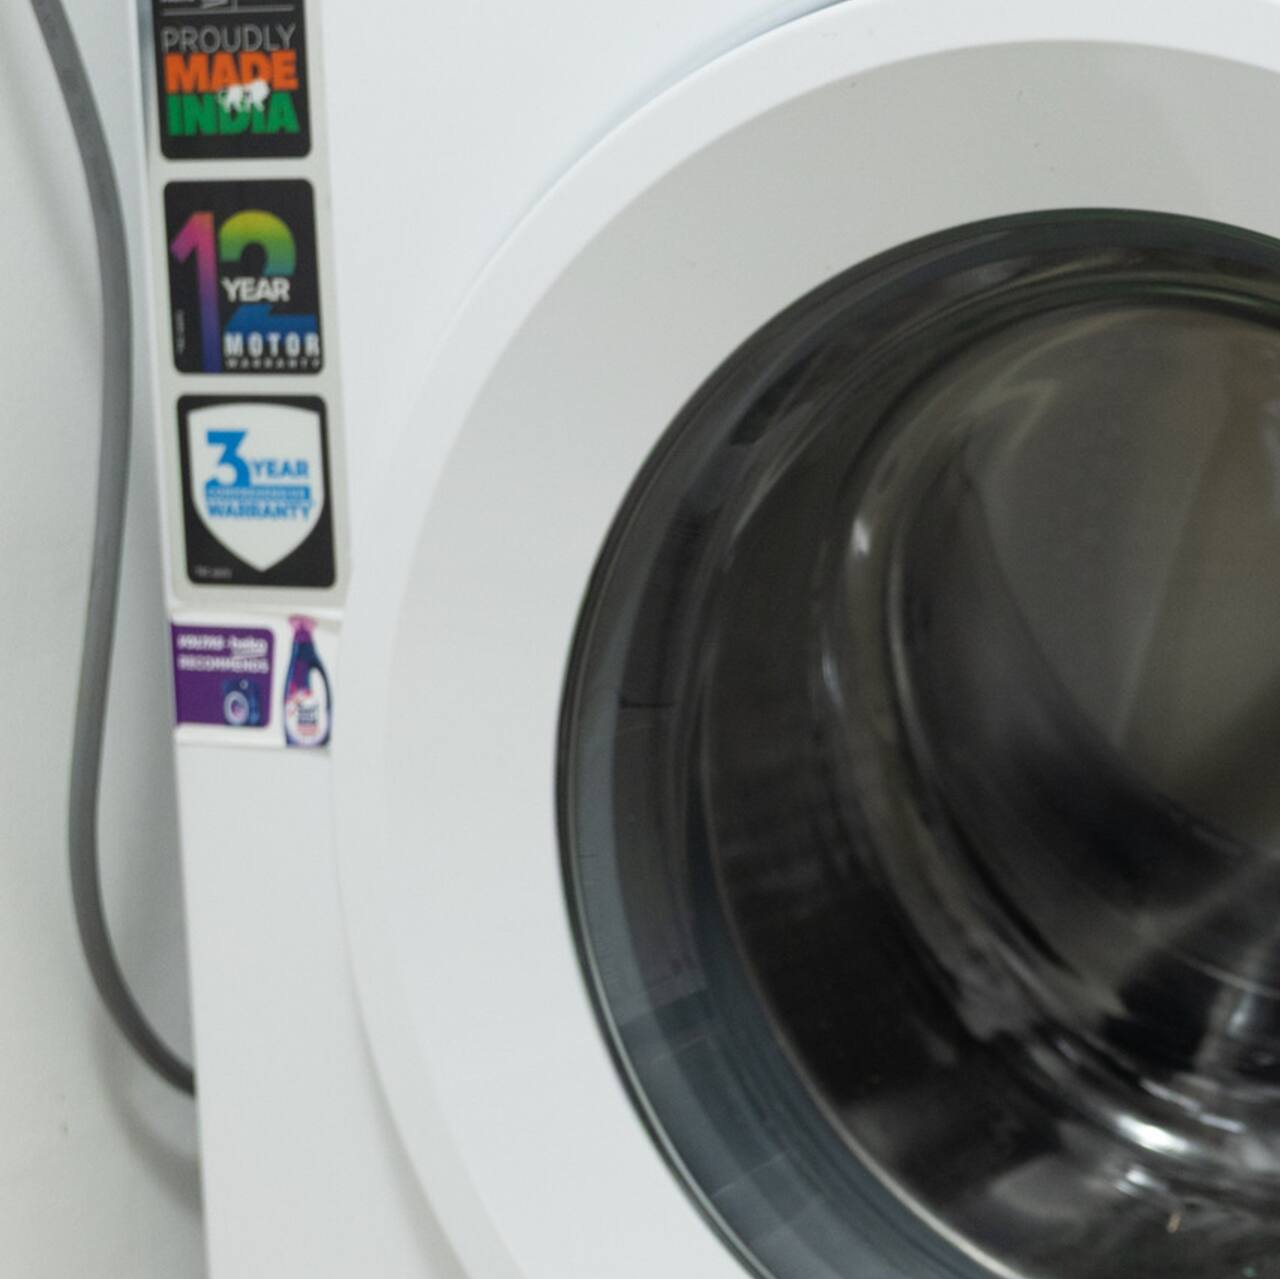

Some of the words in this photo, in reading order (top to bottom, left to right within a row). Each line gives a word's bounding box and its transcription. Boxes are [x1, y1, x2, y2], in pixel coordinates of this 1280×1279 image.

[161, 24, 296, 54] PROUDLY
[164, 49, 298, 94] MADE
[166, 90, 299, 136] INDIA
[221, 277, 291, 302] YEAR
[224, 331, 320, 357] MOTOR
[205, 430, 251, 487] 3
[251, 459, 309, 479] YEAR
[208, 502, 314, 520] WARRANTY
